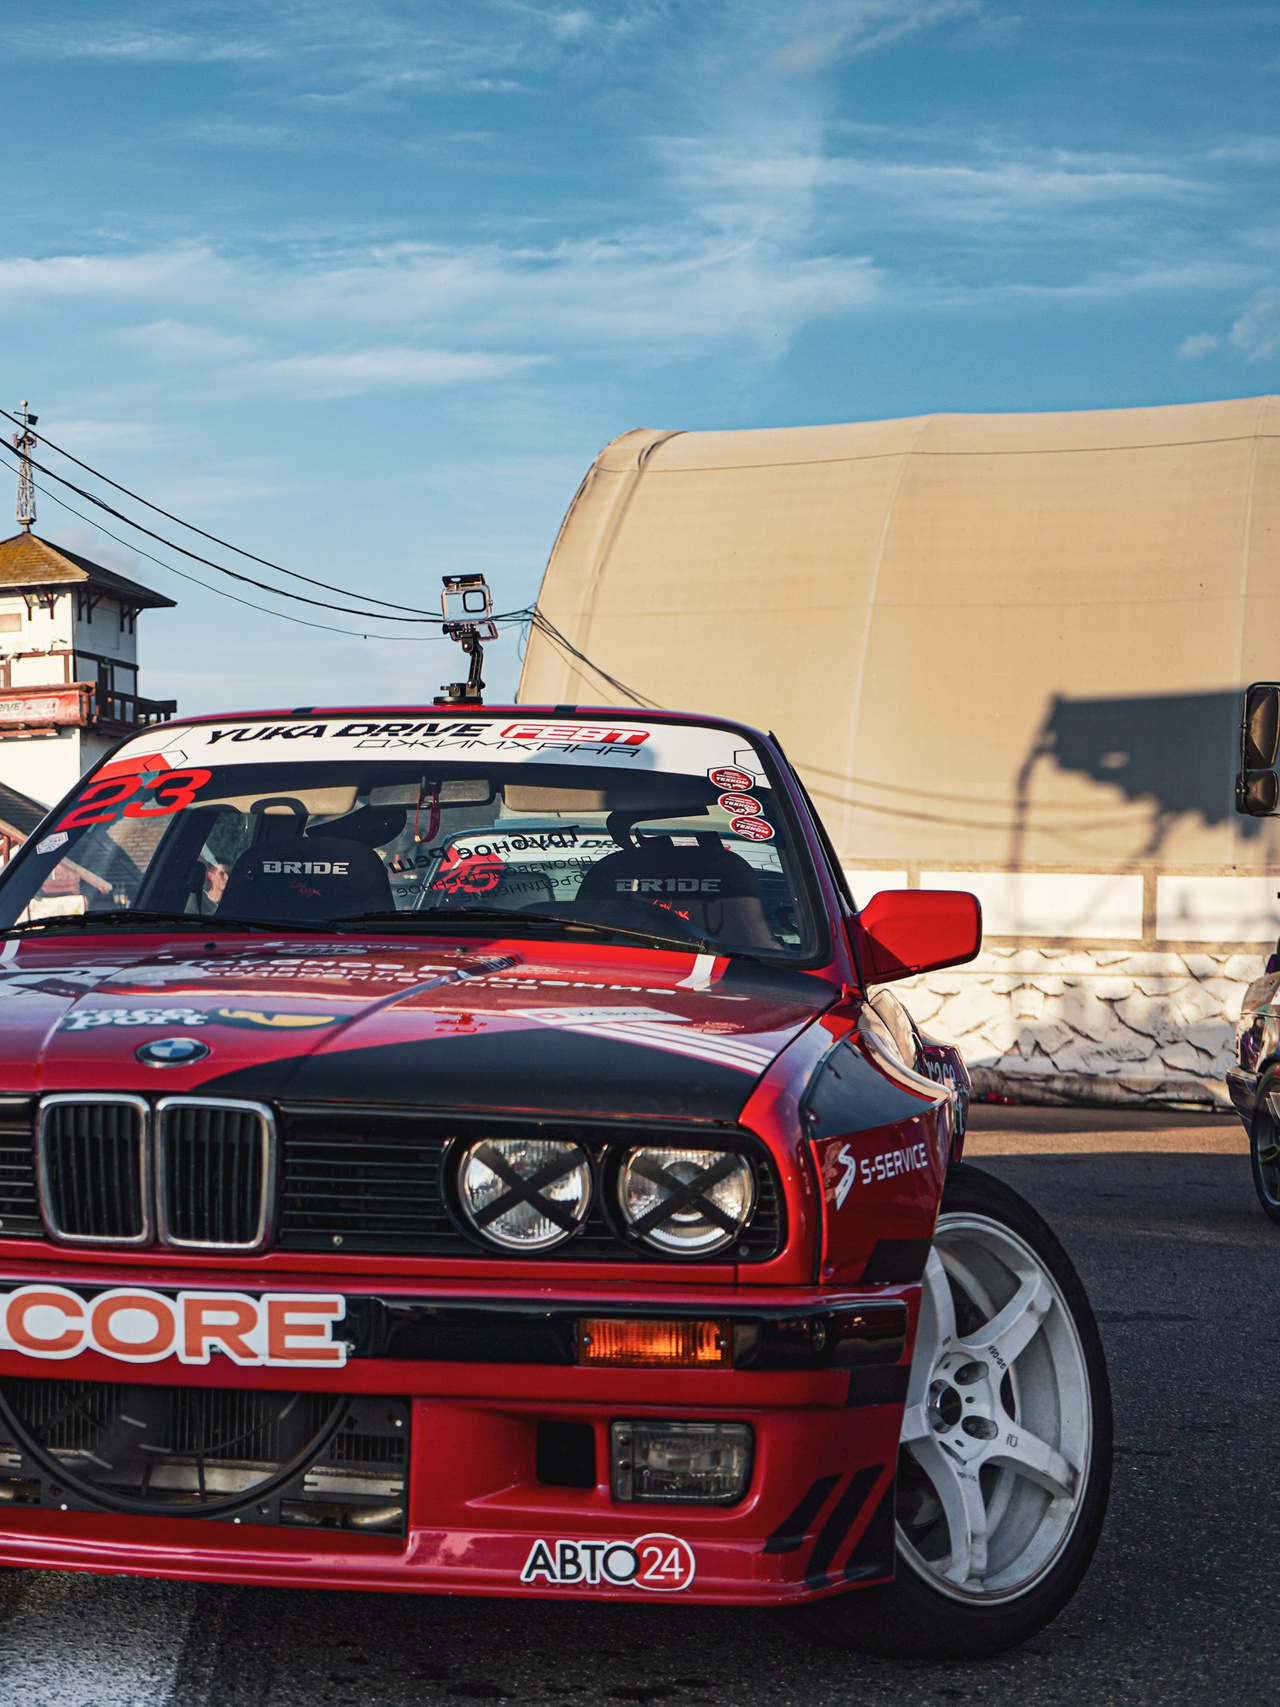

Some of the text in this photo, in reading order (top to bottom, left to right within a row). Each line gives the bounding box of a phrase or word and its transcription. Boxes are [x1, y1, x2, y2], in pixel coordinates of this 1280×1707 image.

[205, 722, 649, 745] YUKA DRIVE FEST
[353, 739, 643, 758] ДЖИМХАНА
[53, 769, 213, 833] 23
[262, 861, 350, 875] BRIDE
[431, 865, 505, 894] 45
[614, 878, 722, 892] BRIDE
[66, 1013, 209, 1030] port
[67, 1008, 198, 1019] race
[860, 1143, 928, 1185] S-SERVICE
